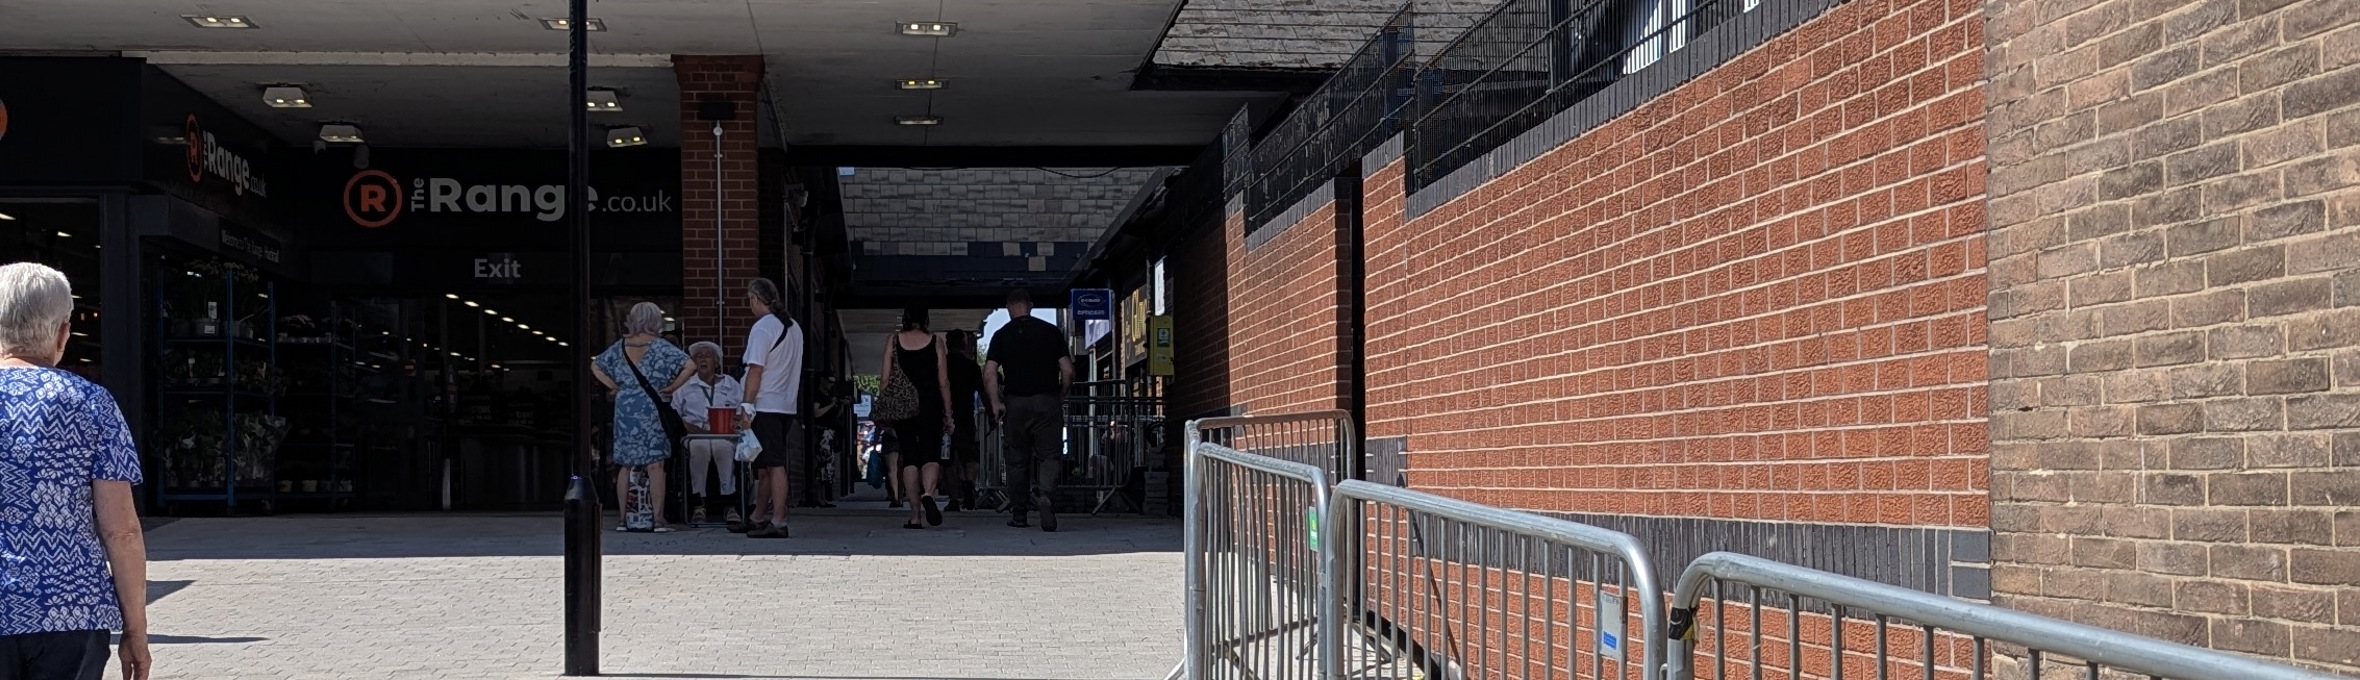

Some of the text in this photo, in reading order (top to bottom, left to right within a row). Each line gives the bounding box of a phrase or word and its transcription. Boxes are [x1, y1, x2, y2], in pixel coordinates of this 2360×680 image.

[206, 131, 250, 197] Range
[360, 183, 387, 213] R
[411, 177, 425, 213] The
[602, 188, 673, 213] .co.uk
[474, 257, 522, 278] Exit
